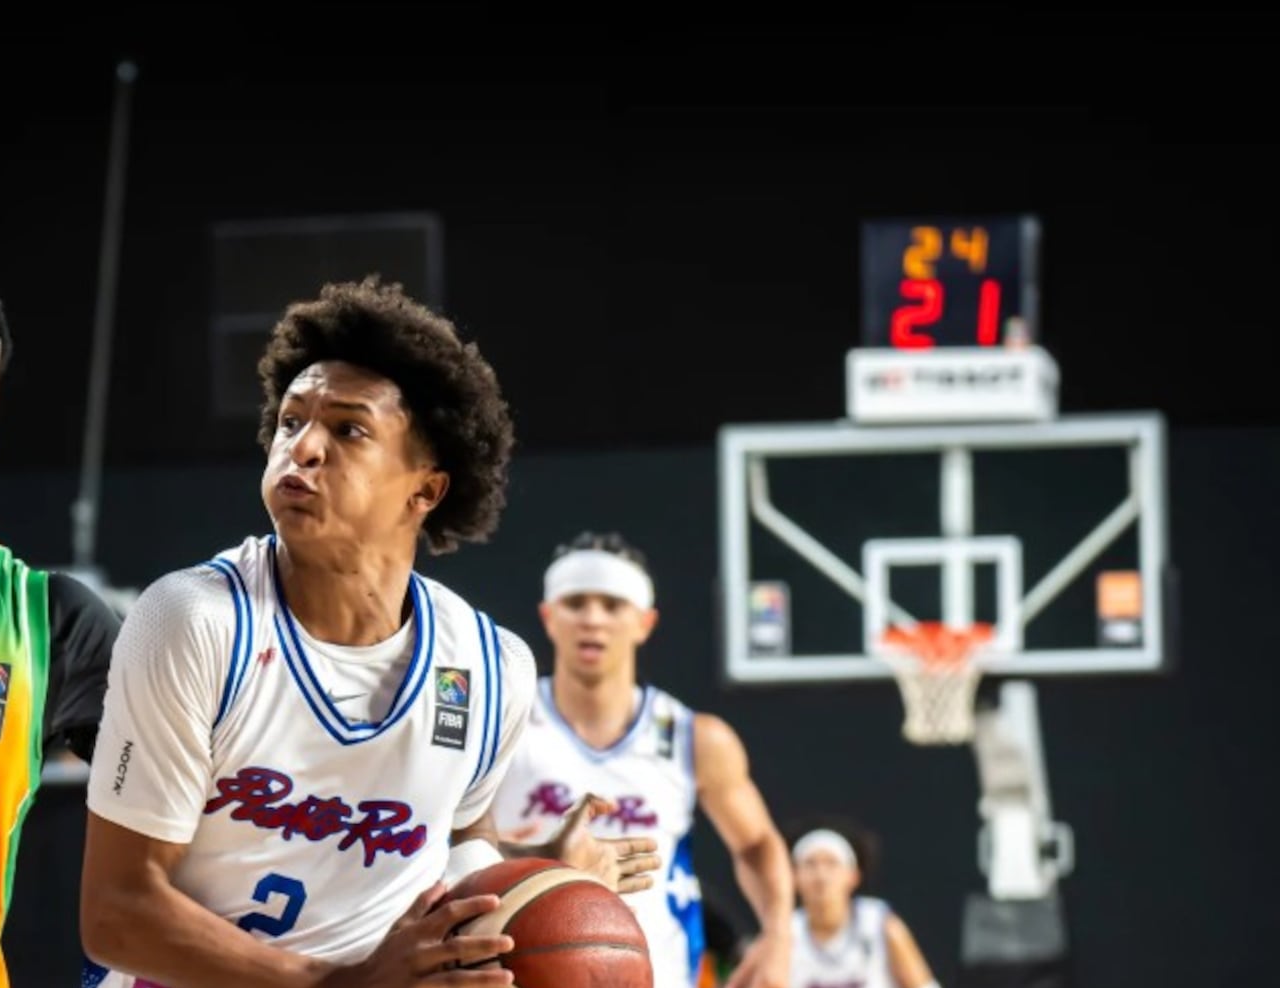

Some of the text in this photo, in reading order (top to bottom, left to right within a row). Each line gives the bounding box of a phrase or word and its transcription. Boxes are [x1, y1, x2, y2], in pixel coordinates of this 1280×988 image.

[903, 226, 989, 279] 24
[890, 279, 1000, 352] 21
[438, 711, 464, 729] FIBA
[238, 872, 307, 938] 2
